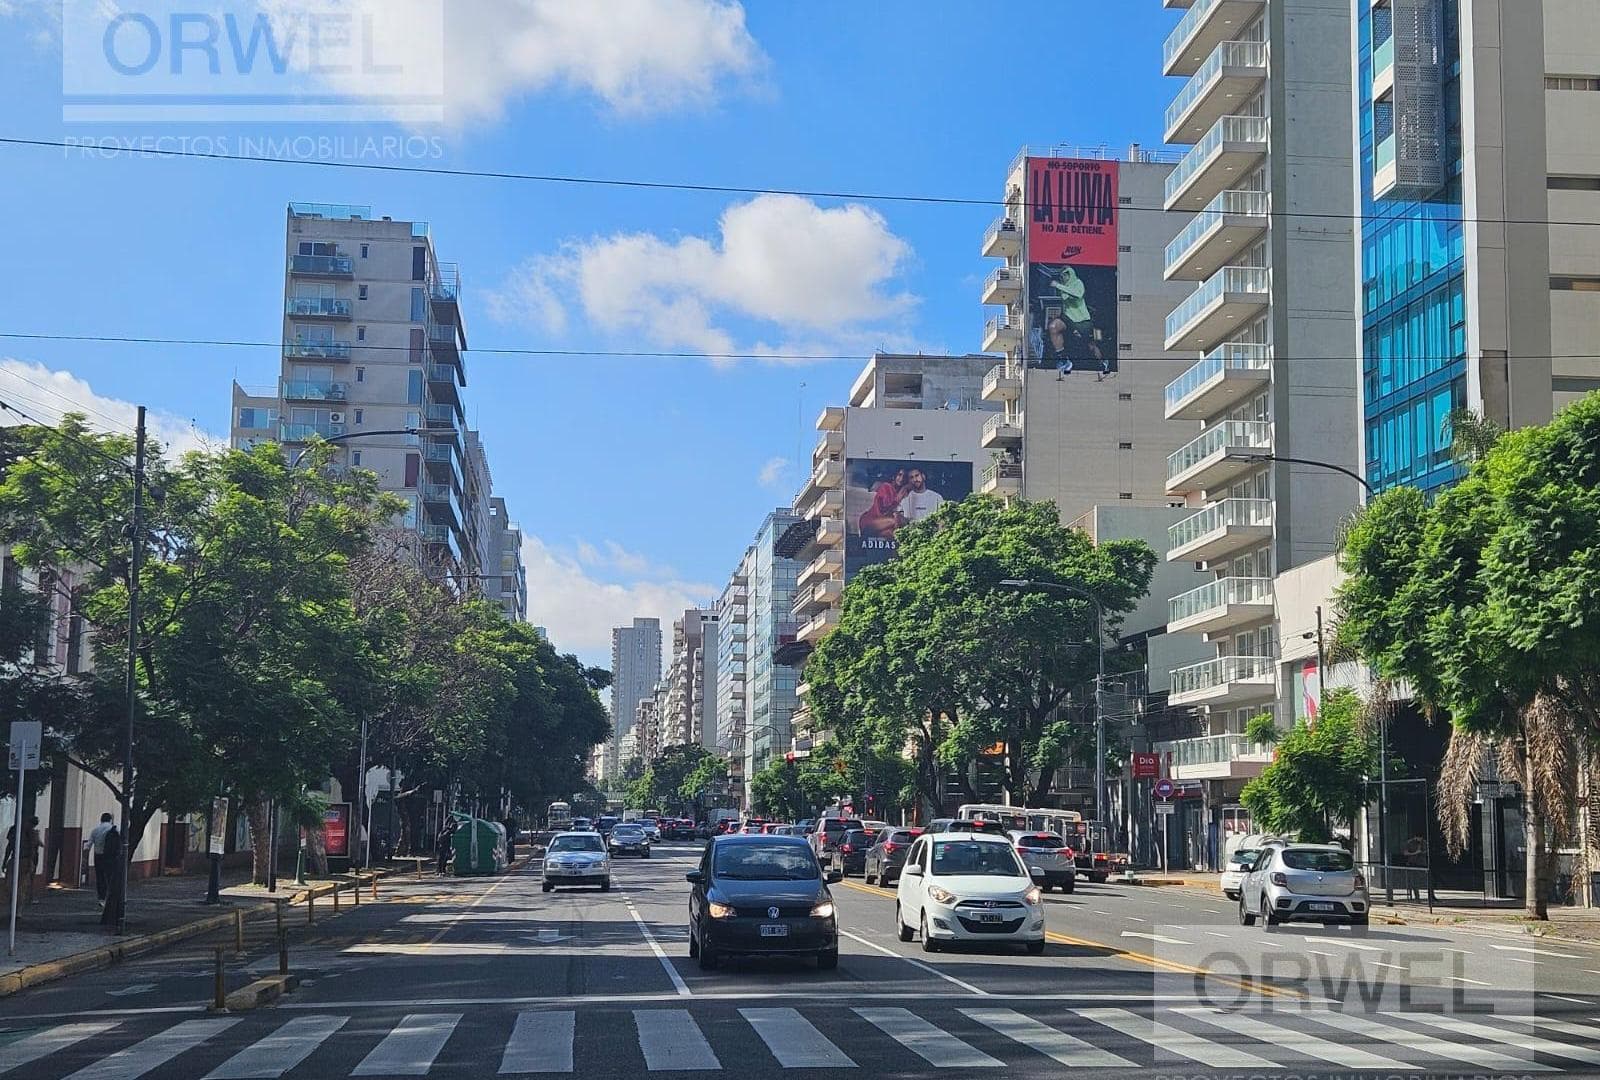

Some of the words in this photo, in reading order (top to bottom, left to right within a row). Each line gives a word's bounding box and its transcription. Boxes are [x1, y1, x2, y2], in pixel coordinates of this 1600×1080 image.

[1033, 170, 1053, 222] LA
[1058, 170, 1113, 225] LLUVIA
[1042, 224, 1054, 232] NO
[1056, 225, 1069, 233] ME
[862, 540, 896, 549] ADIDAS
